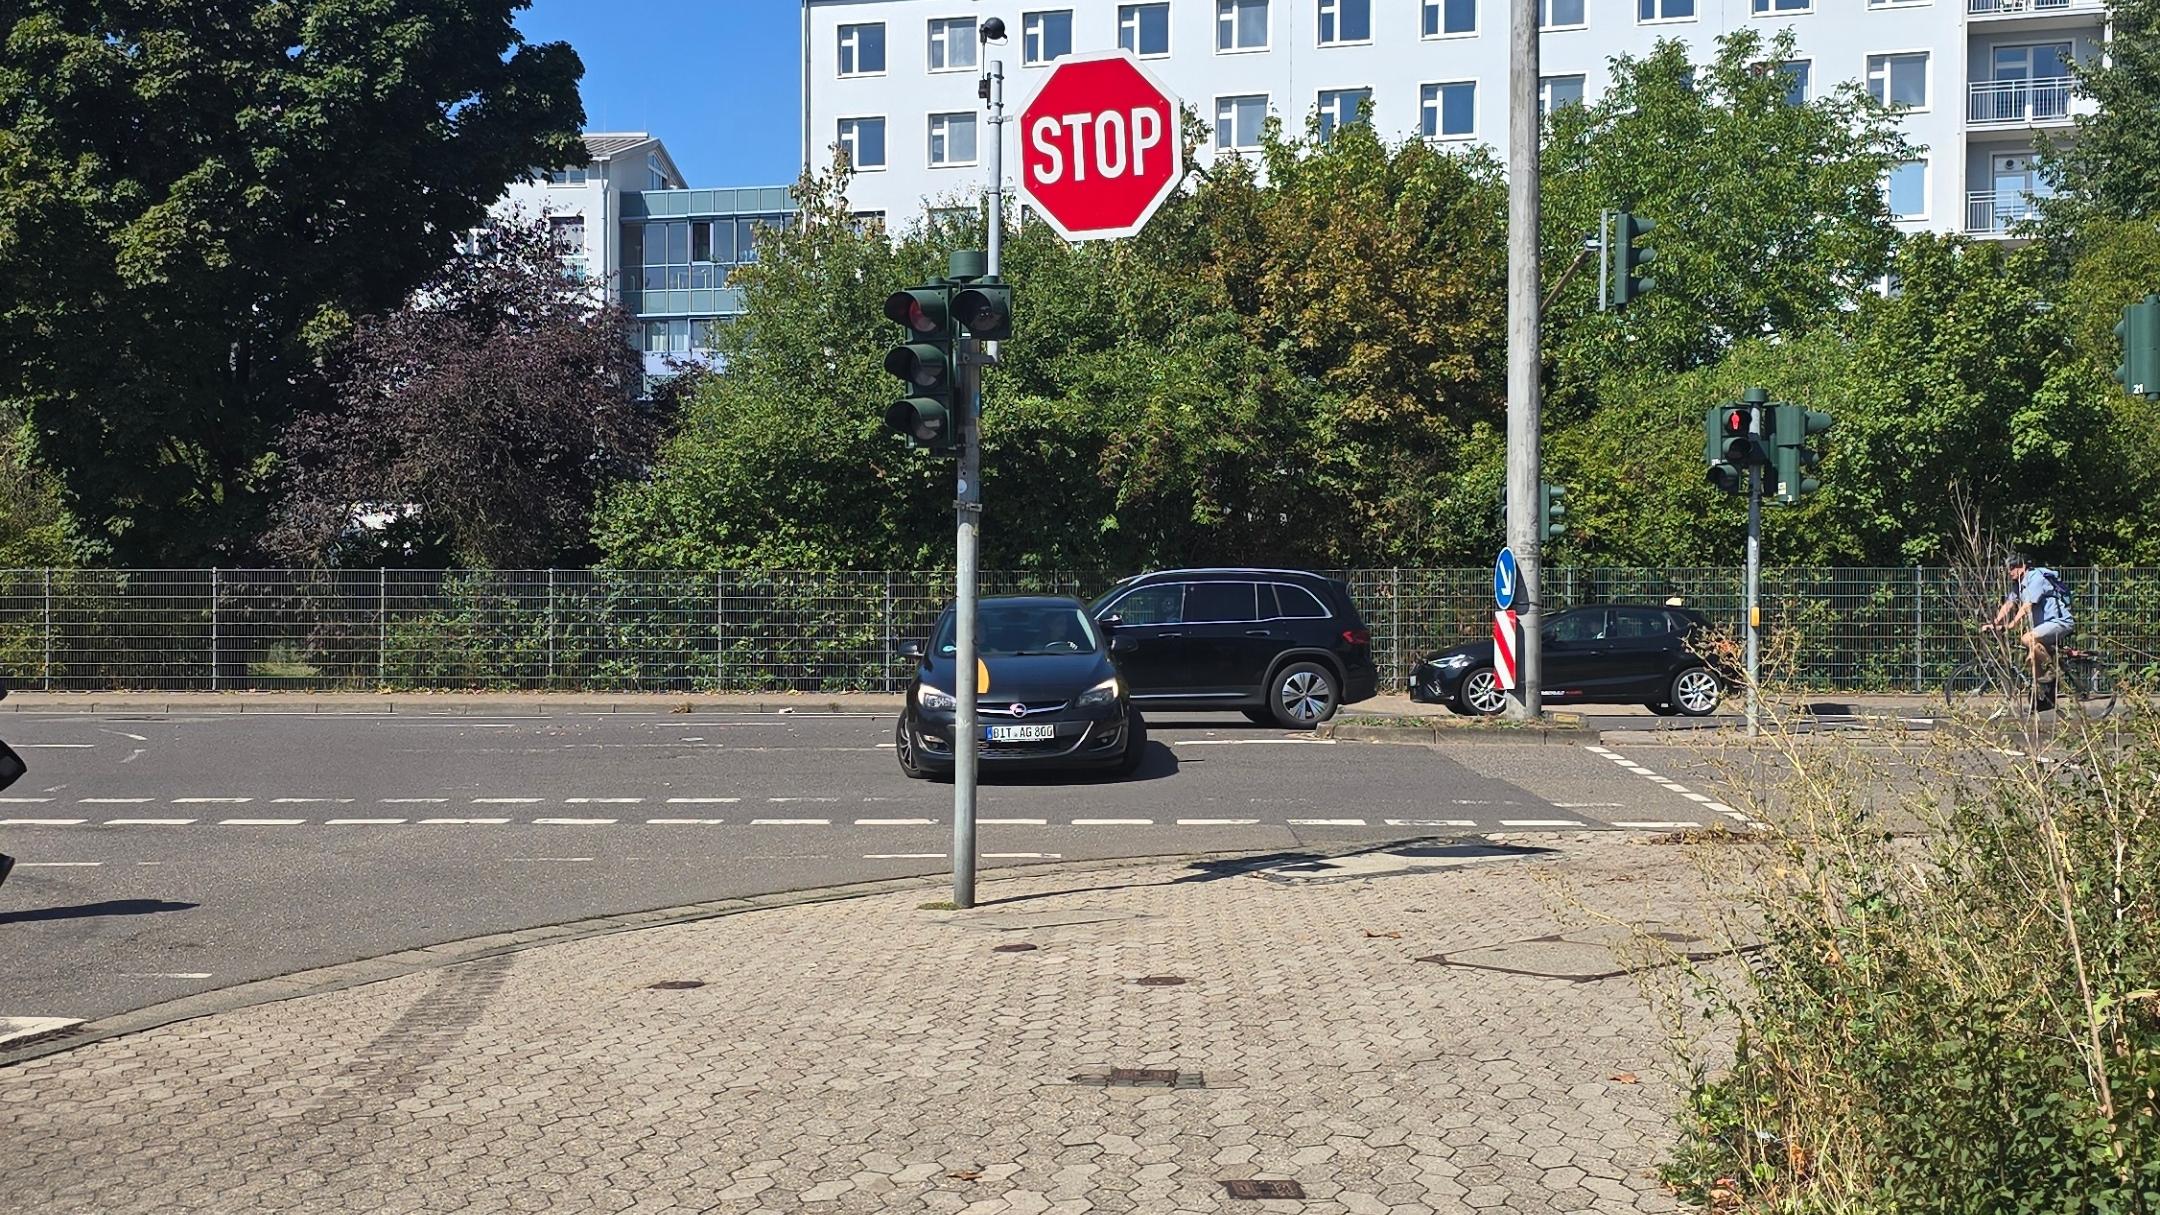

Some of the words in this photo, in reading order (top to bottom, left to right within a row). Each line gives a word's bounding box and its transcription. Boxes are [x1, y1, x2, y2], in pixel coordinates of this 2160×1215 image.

[1032, 107, 1161, 184] STOP
[993, 727, 1011, 739] BIT
[1019, 726, 1032, 738] AG
